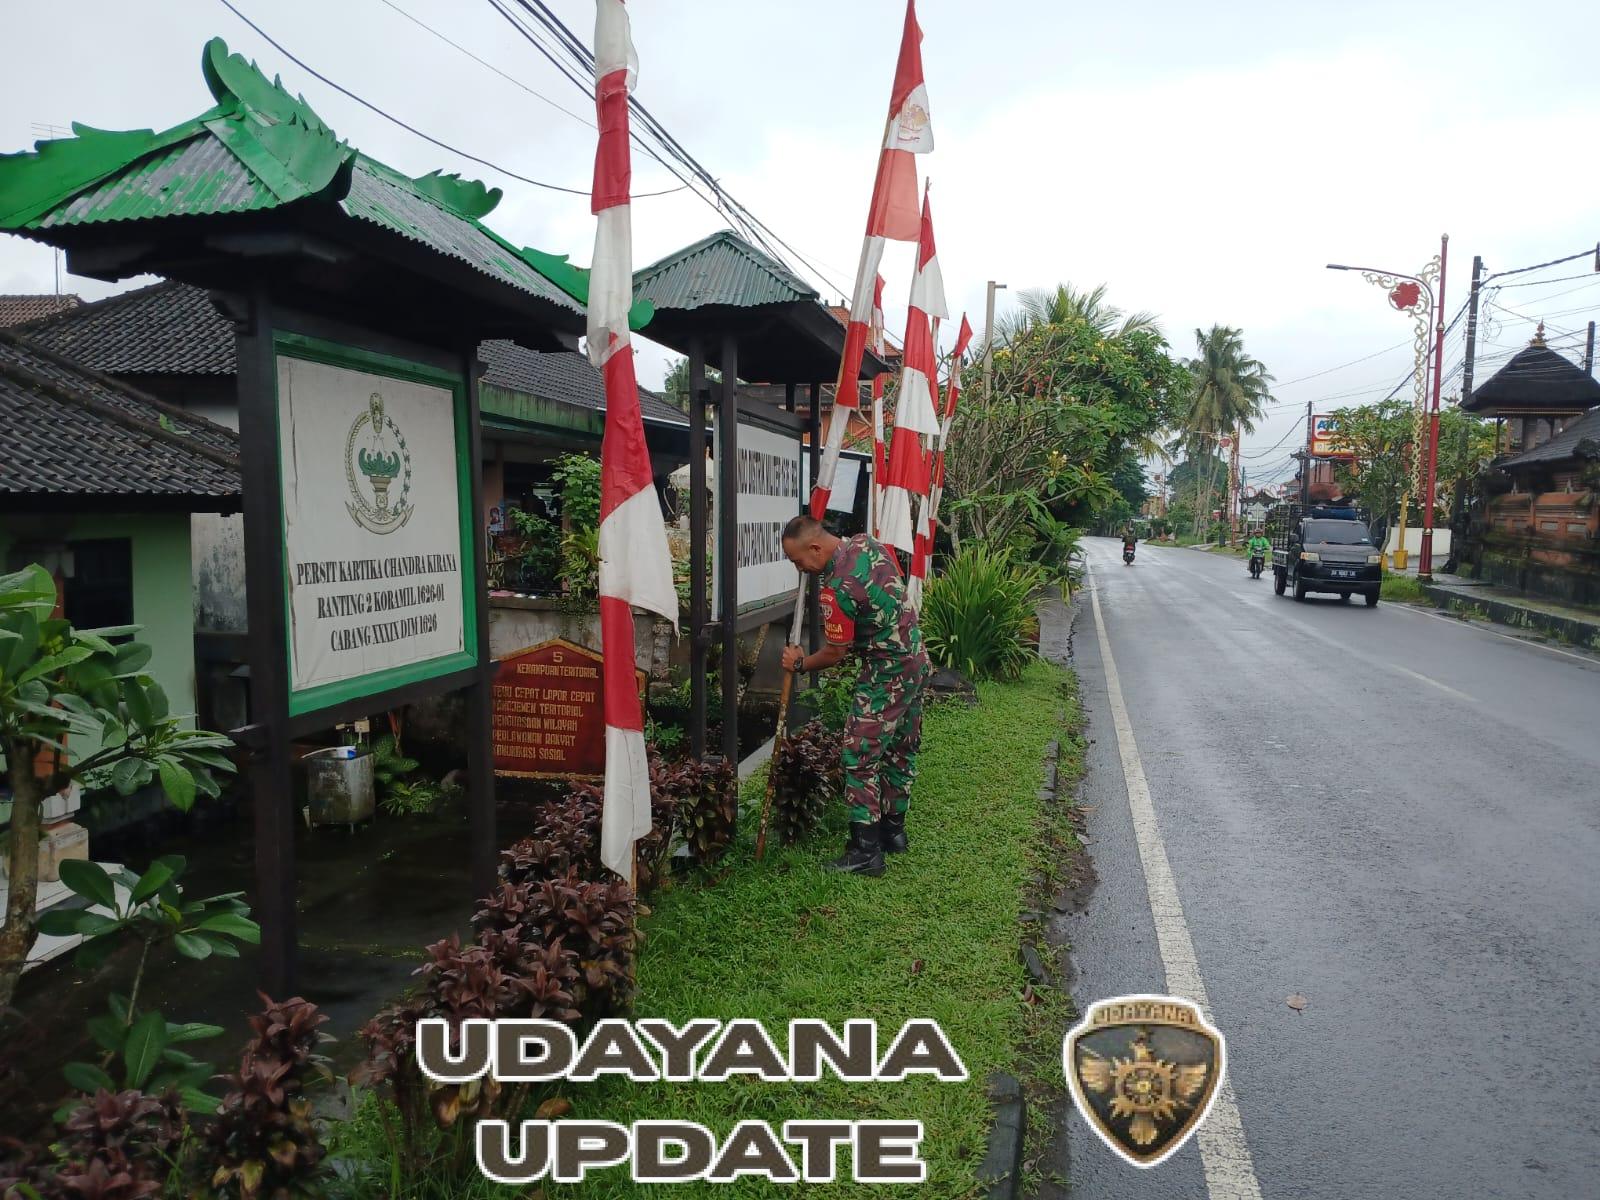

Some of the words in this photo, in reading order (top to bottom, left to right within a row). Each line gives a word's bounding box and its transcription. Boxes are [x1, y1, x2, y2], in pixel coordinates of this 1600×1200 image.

[296, 561, 338, 585] PERSIT
[340, 559, 383, 582] KARTIKA
[384, 556, 426, 579] CHANDRA
[427, 553, 457, 573] KIRANA
[317, 593, 365, 618] RANTING
[366, 592, 373, 613] 2
[374, 586, 417, 612] KORAMIL
[330, 625, 371, 651] CABANG
[401, 615, 419, 638] DIM
[419, 613, 438, 633] 1626
[553, 651, 563, 663] 5
[514, 687, 540, 700] CEPAT
[543, 688, 567, 700] LAPOR
[570, 690, 596, 703] CEPAT
[539, 747, 566, 760] SOSIAL
